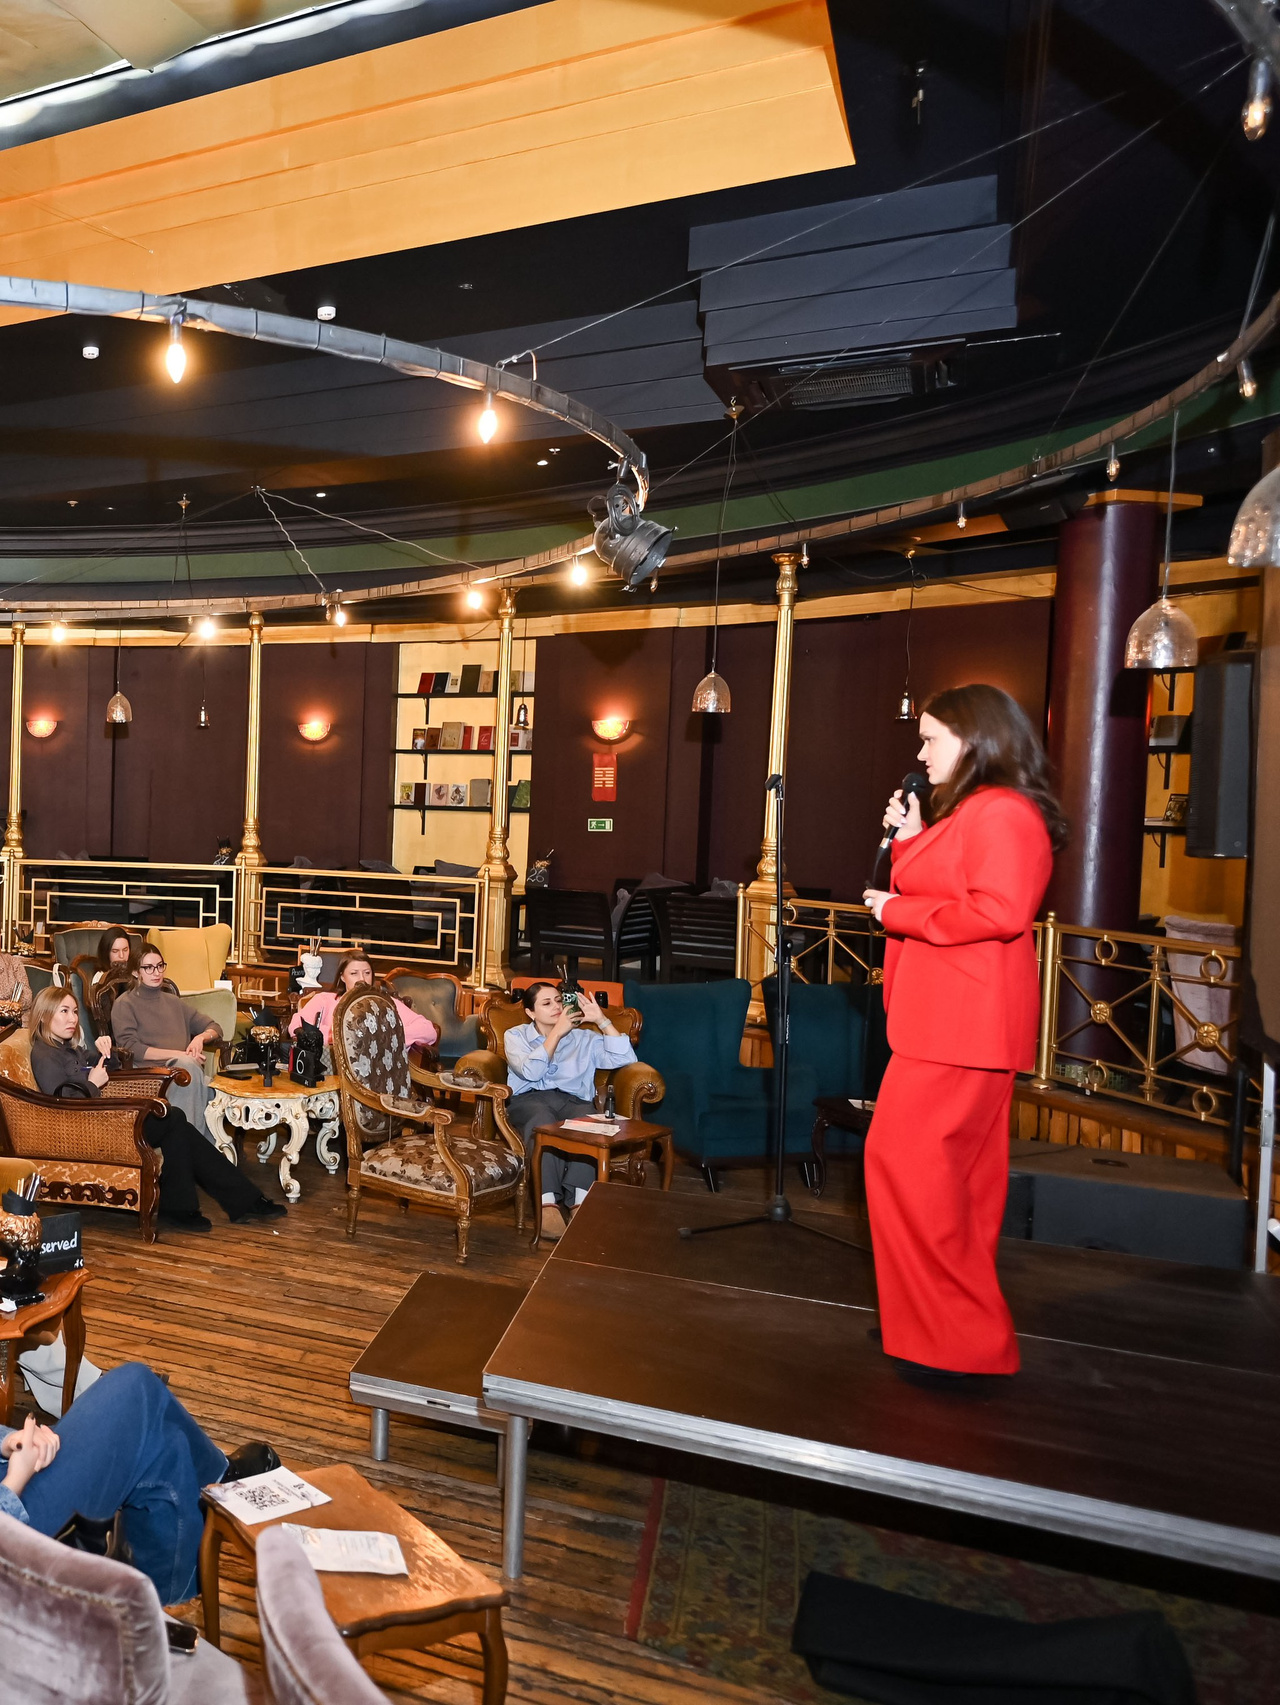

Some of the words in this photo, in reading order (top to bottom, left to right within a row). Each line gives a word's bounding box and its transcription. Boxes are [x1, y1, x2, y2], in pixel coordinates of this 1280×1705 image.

[527, 867, 548, 883] 26
[296, 1049, 306, 1075] 6
[40, 1230, 78, 1254] served
